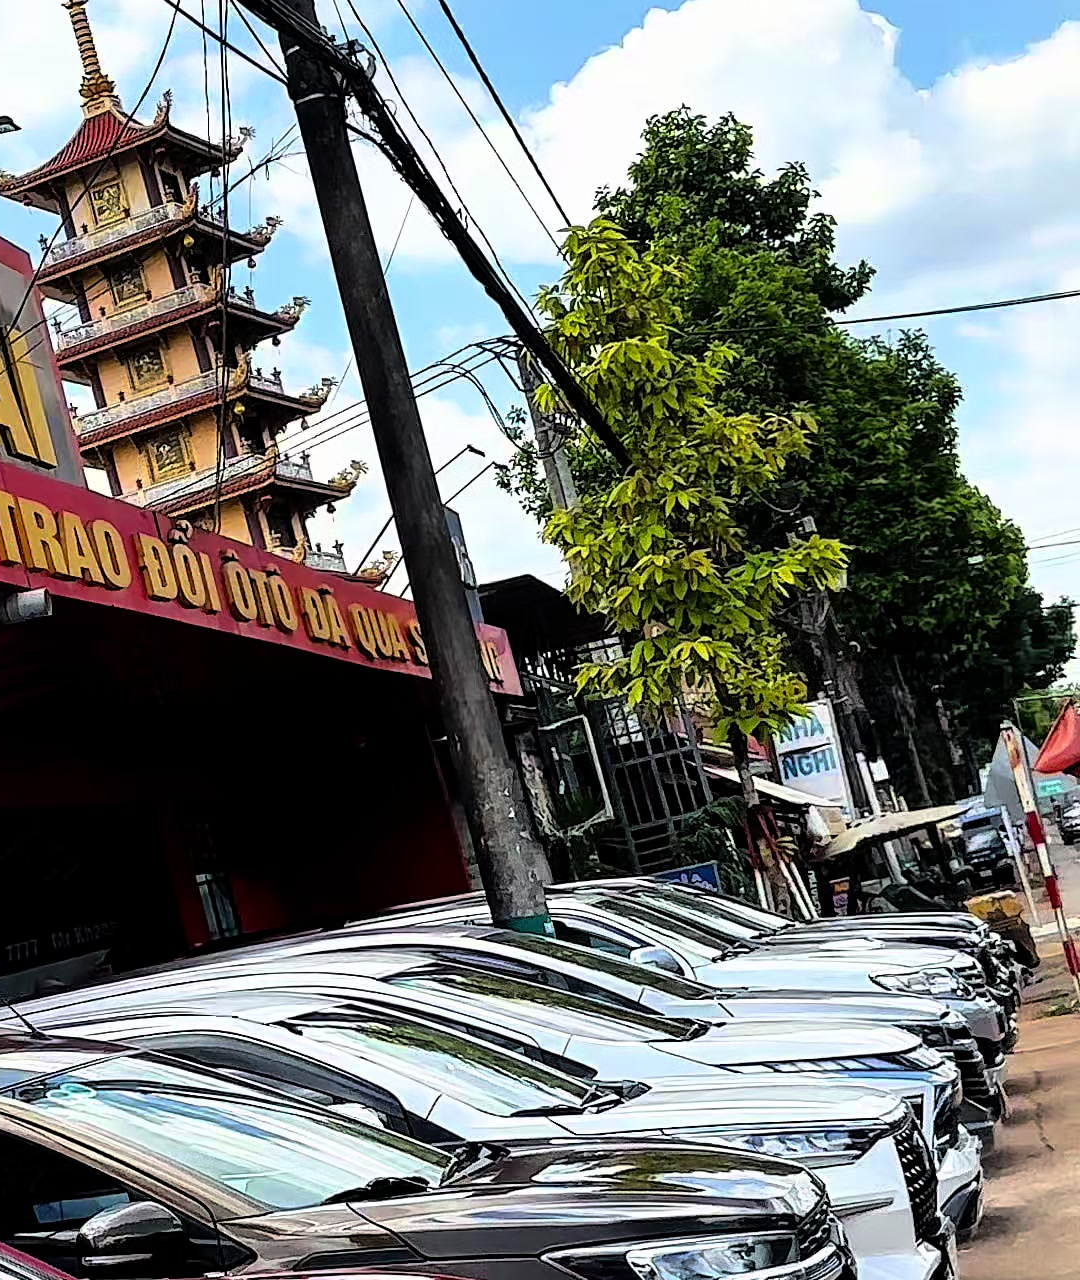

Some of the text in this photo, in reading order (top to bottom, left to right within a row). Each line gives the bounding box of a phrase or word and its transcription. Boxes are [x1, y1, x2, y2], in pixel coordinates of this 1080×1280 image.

[134, 519, 222, 615] ĐỔI
[222, 549, 298, 632] ÔTÔ
[297, 583, 353, 650] ĐÃ
[347, 602, 411, 662] QUA
